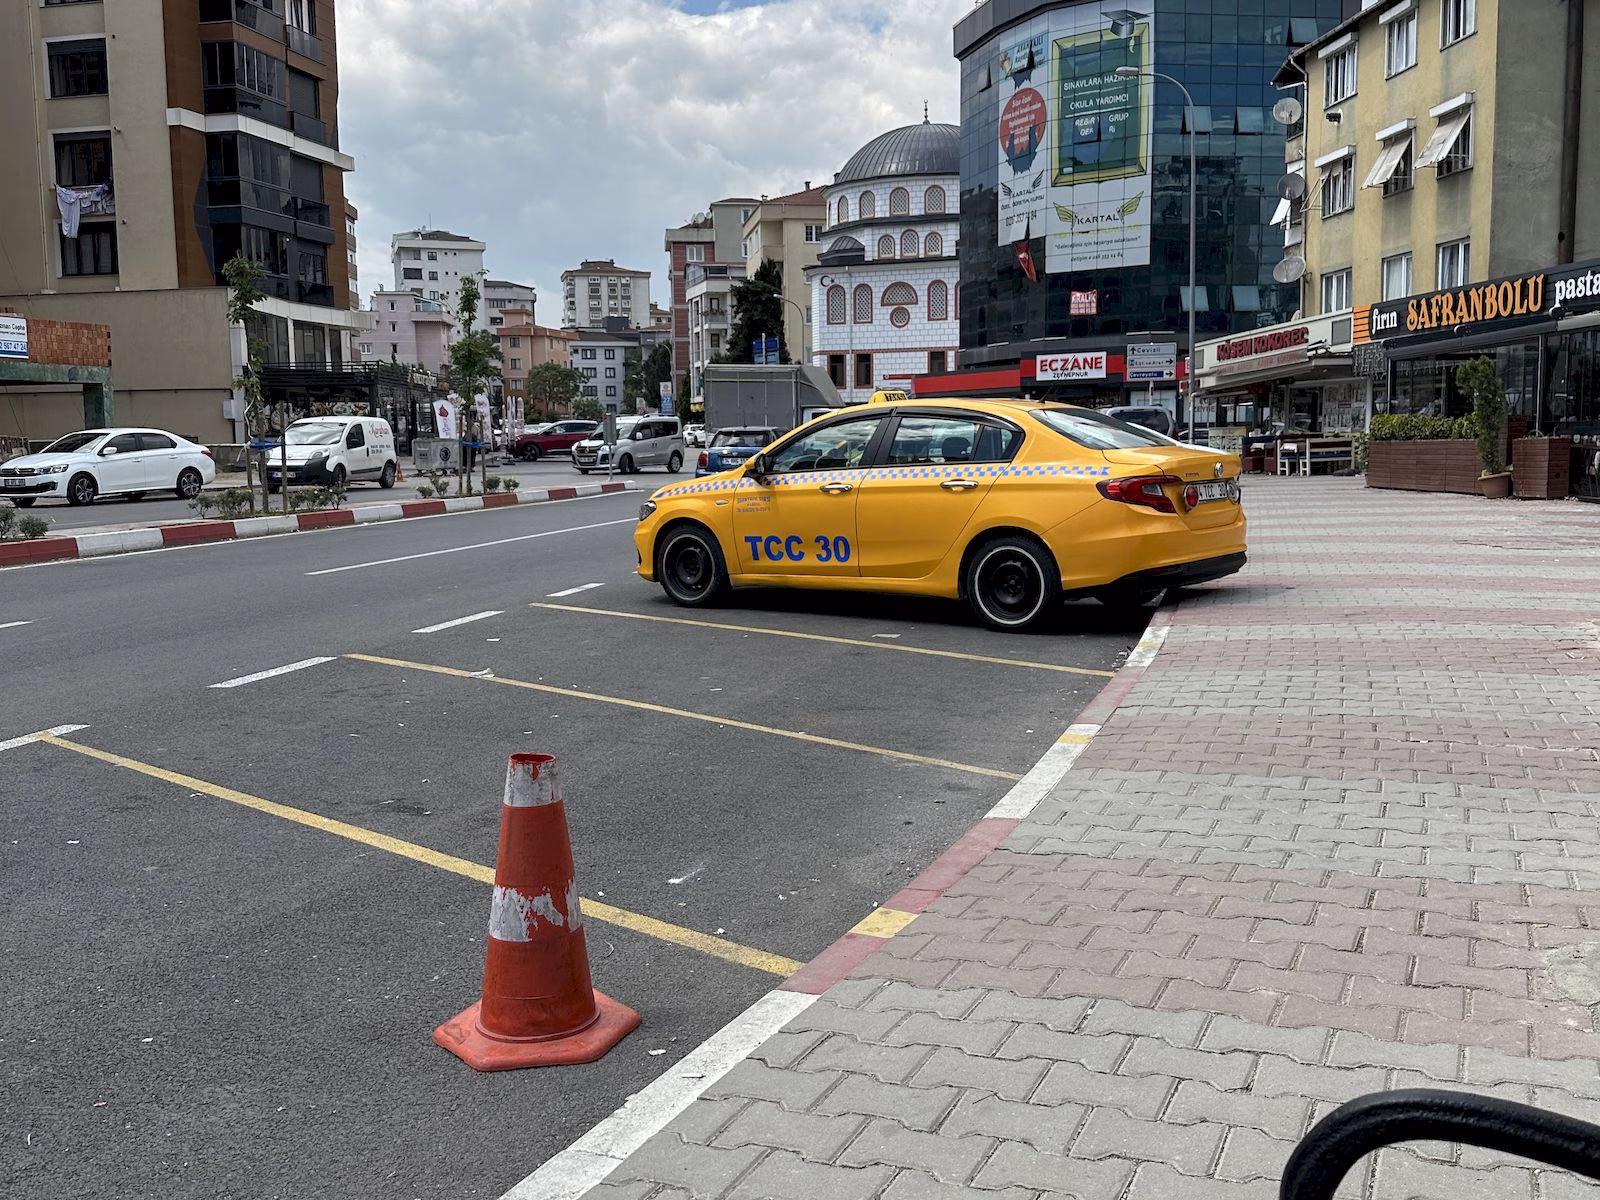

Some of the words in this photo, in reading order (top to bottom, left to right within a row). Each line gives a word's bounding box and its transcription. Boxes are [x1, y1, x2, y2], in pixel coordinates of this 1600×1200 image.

[1070, 99, 1094, 110] OKULA
[1077, 214, 1119, 225] KARTAL
[1371, 308, 1397, 335] fırın
[1406, 273, 1545, 332] SAFRANBOLU
[1039, 356, 1103, 372] ECZANE
[1052, 371, 1089, 380] ZEYNEPNUR
[744, 535, 805, 561] TCC
[814, 535, 851, 563] 30
